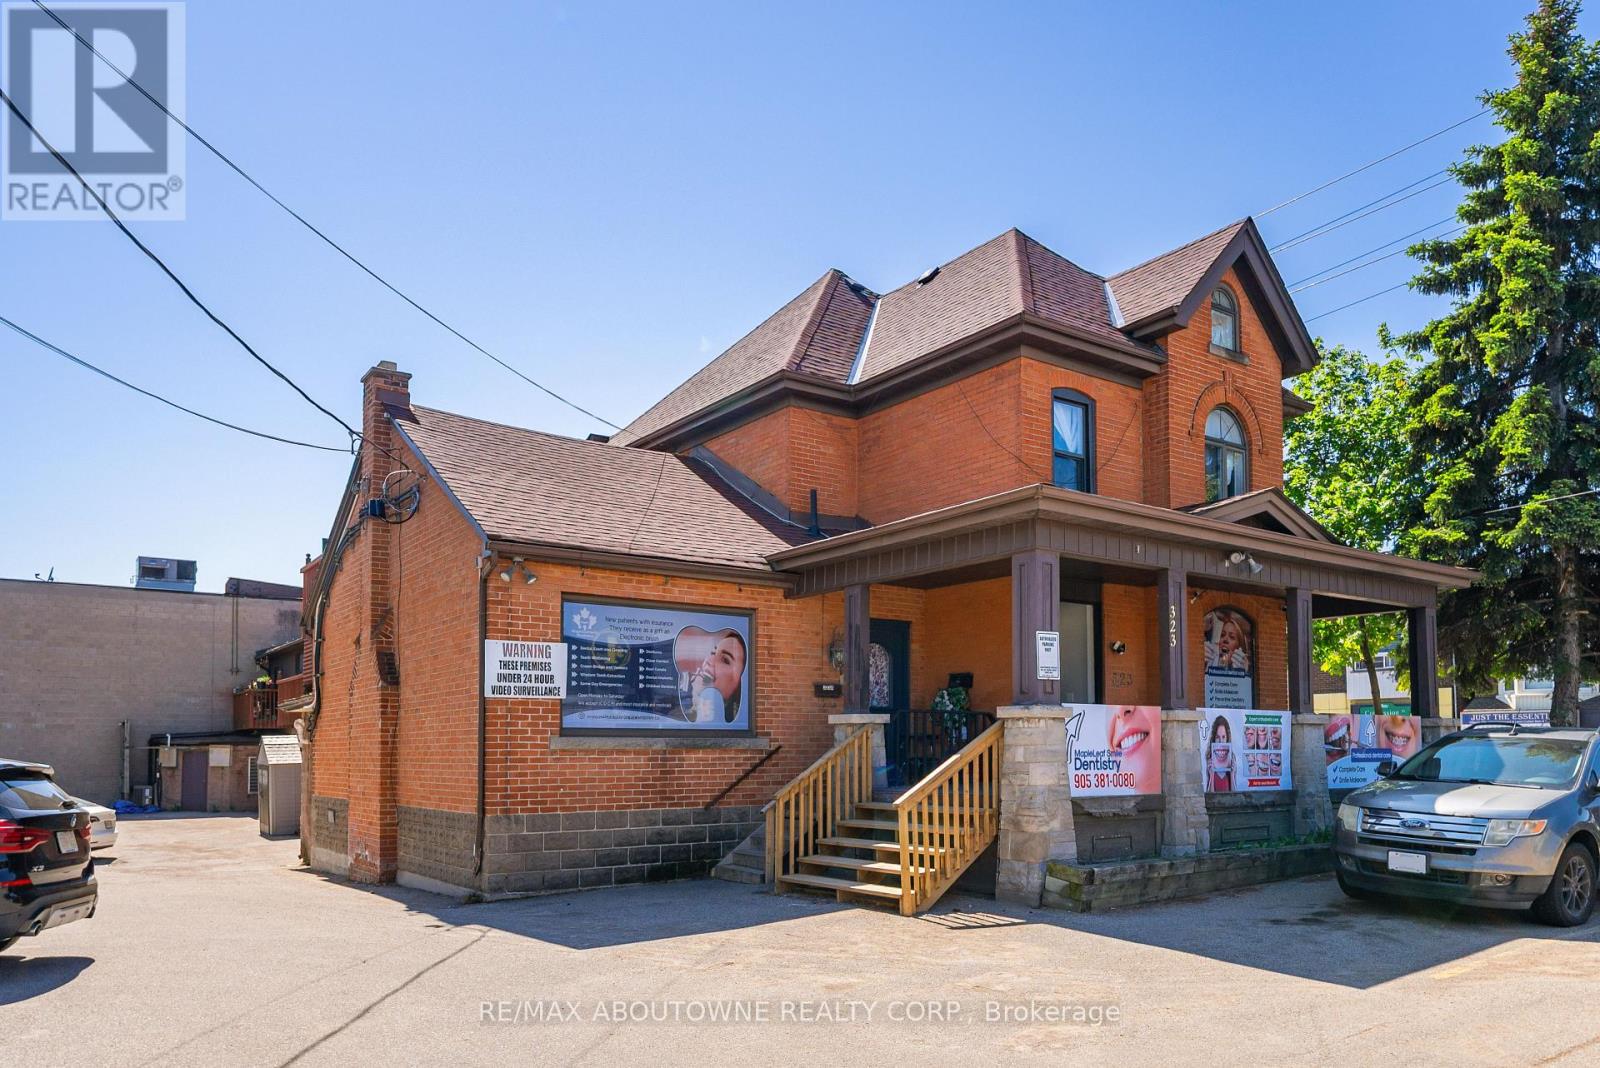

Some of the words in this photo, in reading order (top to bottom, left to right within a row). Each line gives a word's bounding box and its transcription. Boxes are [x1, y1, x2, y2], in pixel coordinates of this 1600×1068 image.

[1169, 605, 1177, 647] 323
[502, 642, 552, 659] WARNING
[499, 660, 518, 670] THESE
[520, 661, 552, 671] PREMISES
[497, 673, 521, 683] UNDER
[523, 674, 532, 684] 24
[534, 675, 554, 684] HOUR
[491, 685, 512, 695] VIDEO
[513, 686, 560, 696] SURVEILLANCE
[1074, 750, 1105, 759] MapleLeaf
[1074, 758, 1121, 773] Dentistry
[1074, 774, 1091, 788] 905
[1094, 773, 1135, 788] 381-0080
